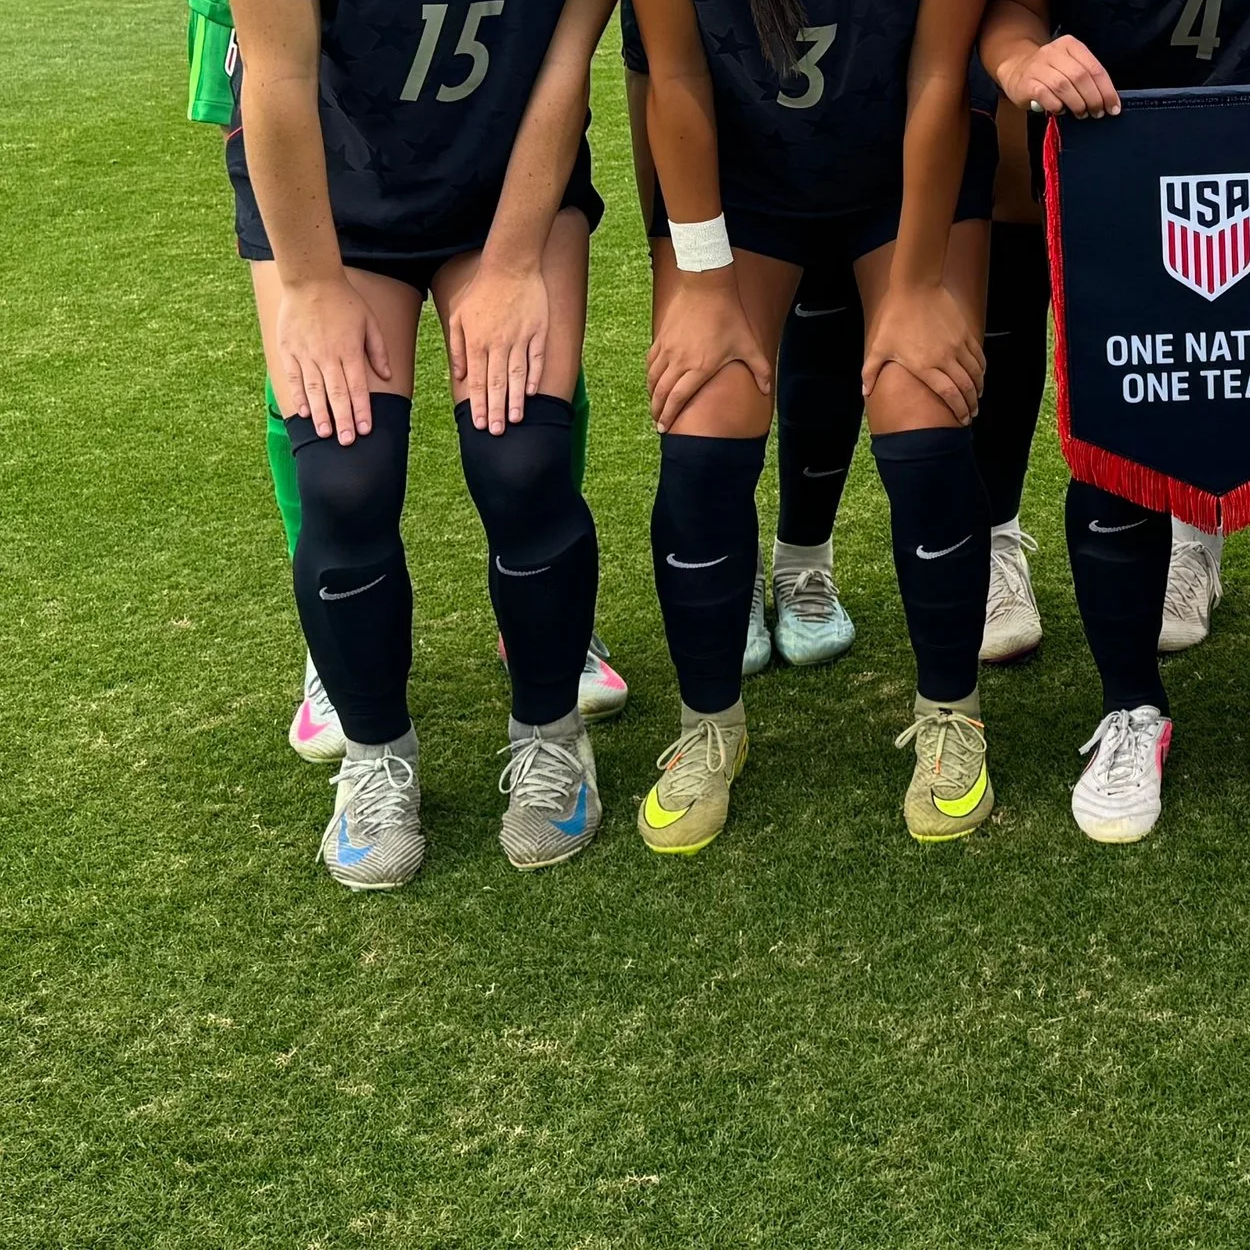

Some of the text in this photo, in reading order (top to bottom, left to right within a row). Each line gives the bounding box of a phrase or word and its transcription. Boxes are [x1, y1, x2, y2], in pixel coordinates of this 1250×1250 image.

[399, 0, 505, 102] 15
[776, 23, 838, 109] 3
[1166, 179, 1250, 229] USA
[1105, 333, 1174, 366] ONE
[1122, 371, 1190, 404] ONE
